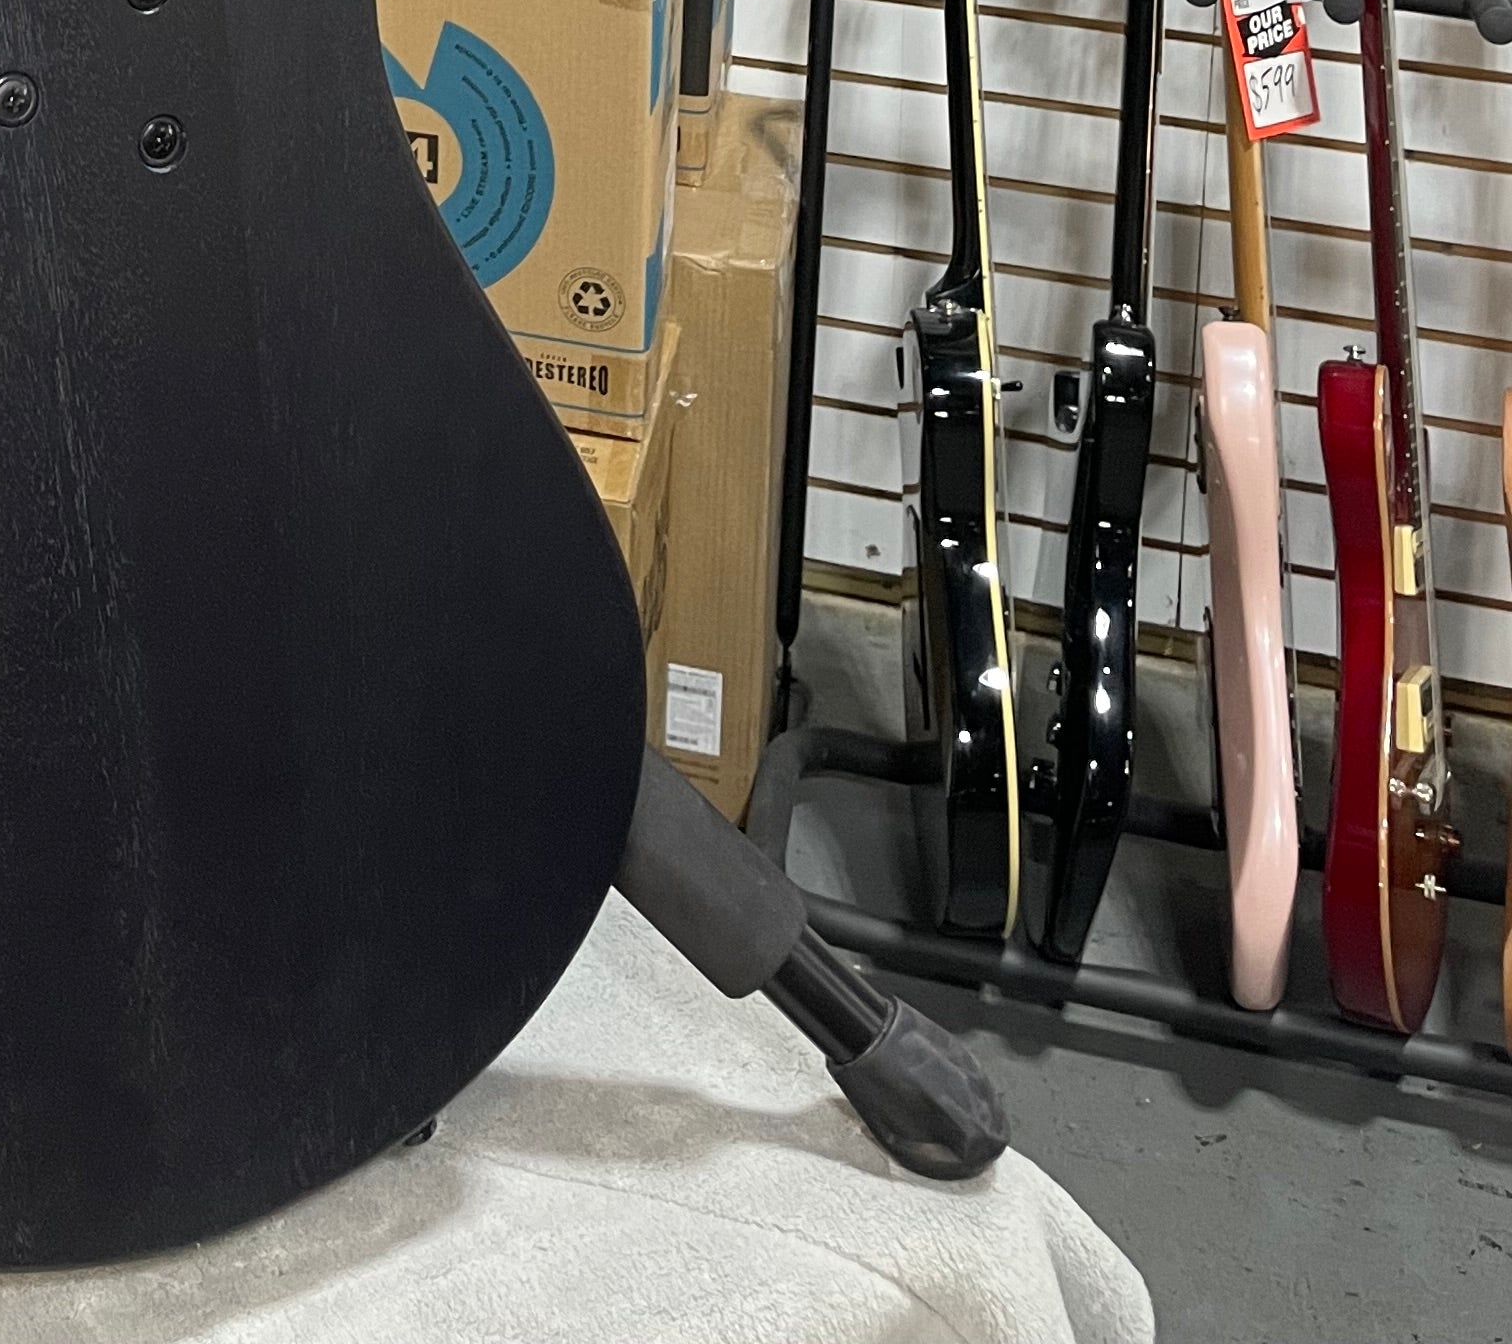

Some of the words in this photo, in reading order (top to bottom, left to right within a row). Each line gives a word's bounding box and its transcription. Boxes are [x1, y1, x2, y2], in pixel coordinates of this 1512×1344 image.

[1246, 18, 1294, 56] PRICE
[1248, 4, 1283, 34] OUR
[1248, 63, 1296, 113] $599
